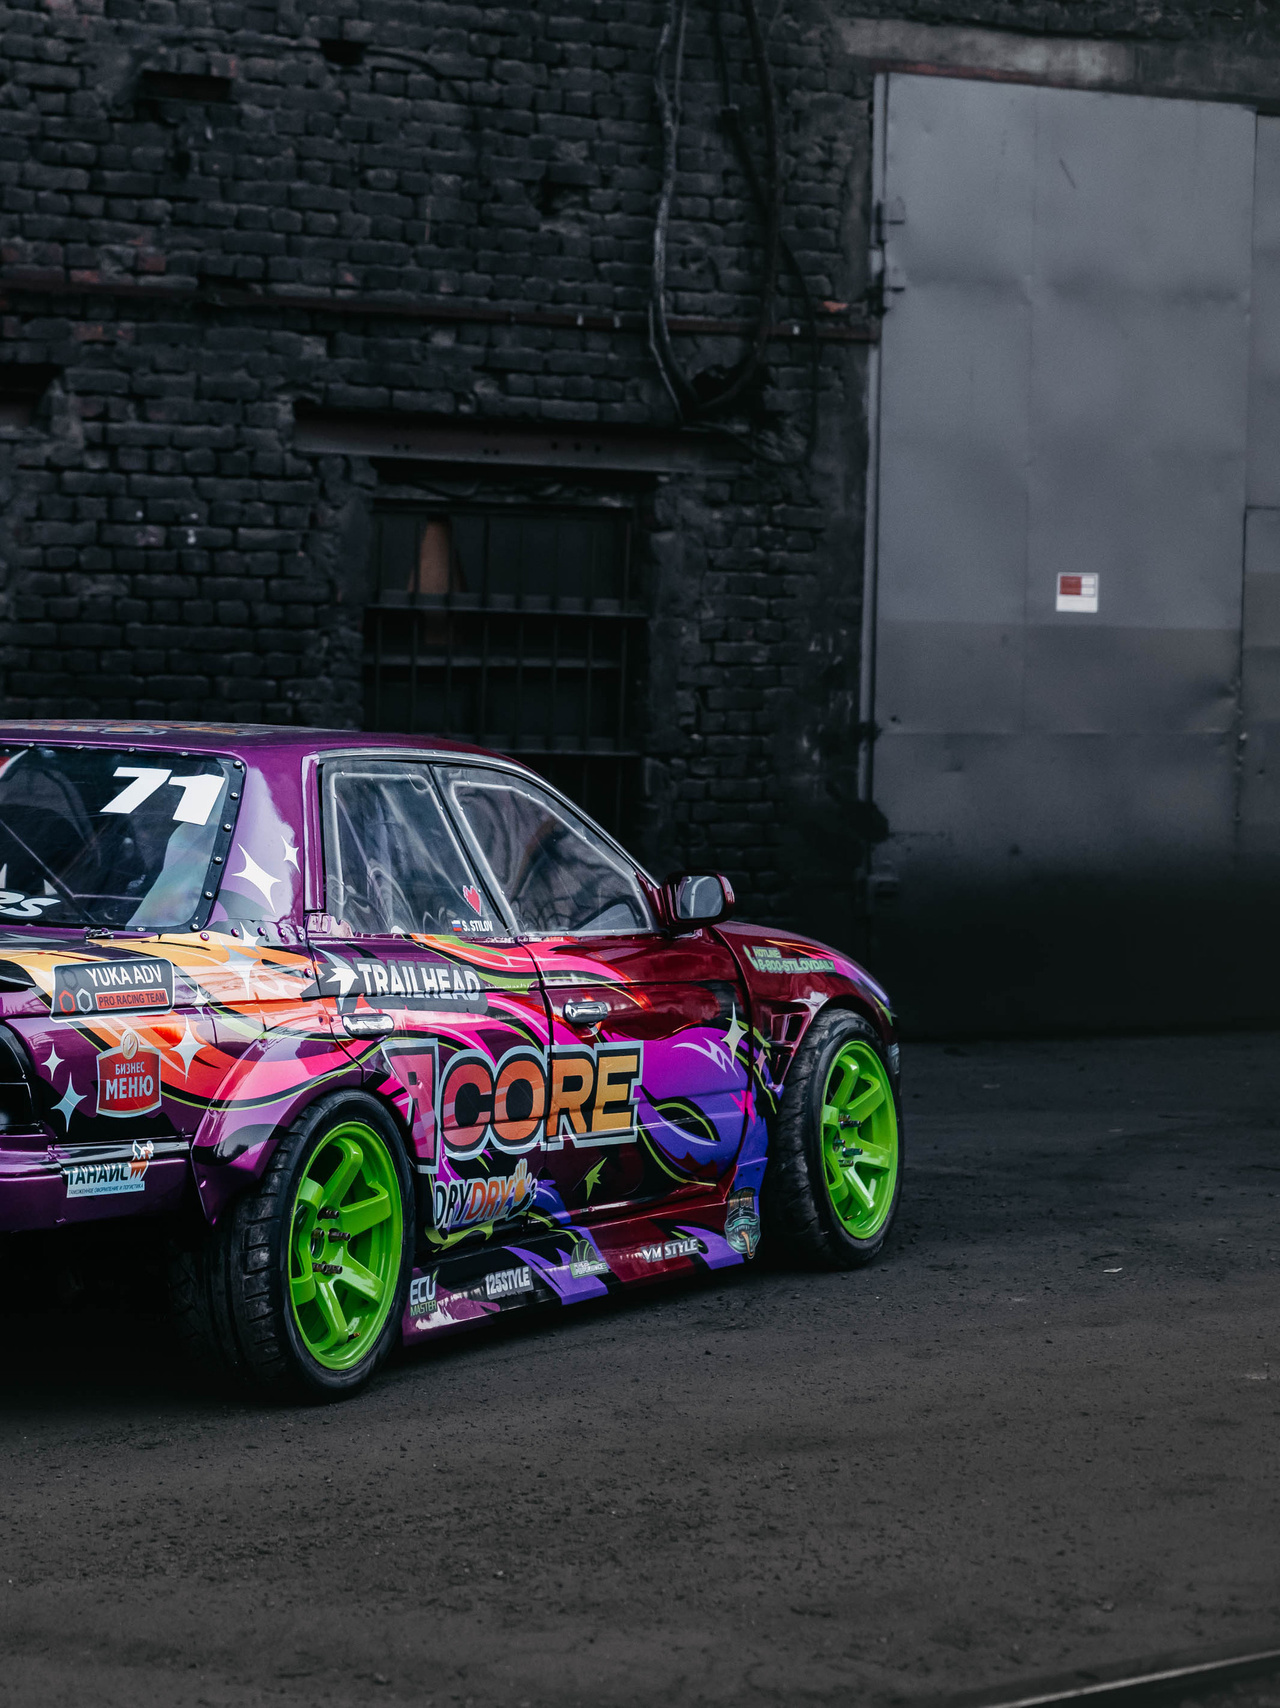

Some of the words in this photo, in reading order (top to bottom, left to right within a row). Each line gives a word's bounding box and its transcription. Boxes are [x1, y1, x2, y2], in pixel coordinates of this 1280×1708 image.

[99, 766, 226, 826] 71
[470, 920, 493, 931] STILOV
[85, 967, 133, 986] YUKA
[133, 964, 162, 984] ADV
[357, 963, 481, 1001] TRAILHEAD
[98, 996, 115, 1006] PRO
[116, 993, 144, 1005] RACING
[145, 992, 167, 1003] TEAM
[115, 1061, 145, 1075] БИЗНЕС
[106, 1075, 154, 1100] МЕНЮ
[63, 1163, 129, 1185] ТАНАИС
[641, 1245, 662, 1260] VM
[664, 1238, 698, 1256] STYLE
[410, 1275, 437, 1306] ECU
[485, 1266, 531, 1296] 125STYLE
[410, 1300, 437, 1317] MASTER
